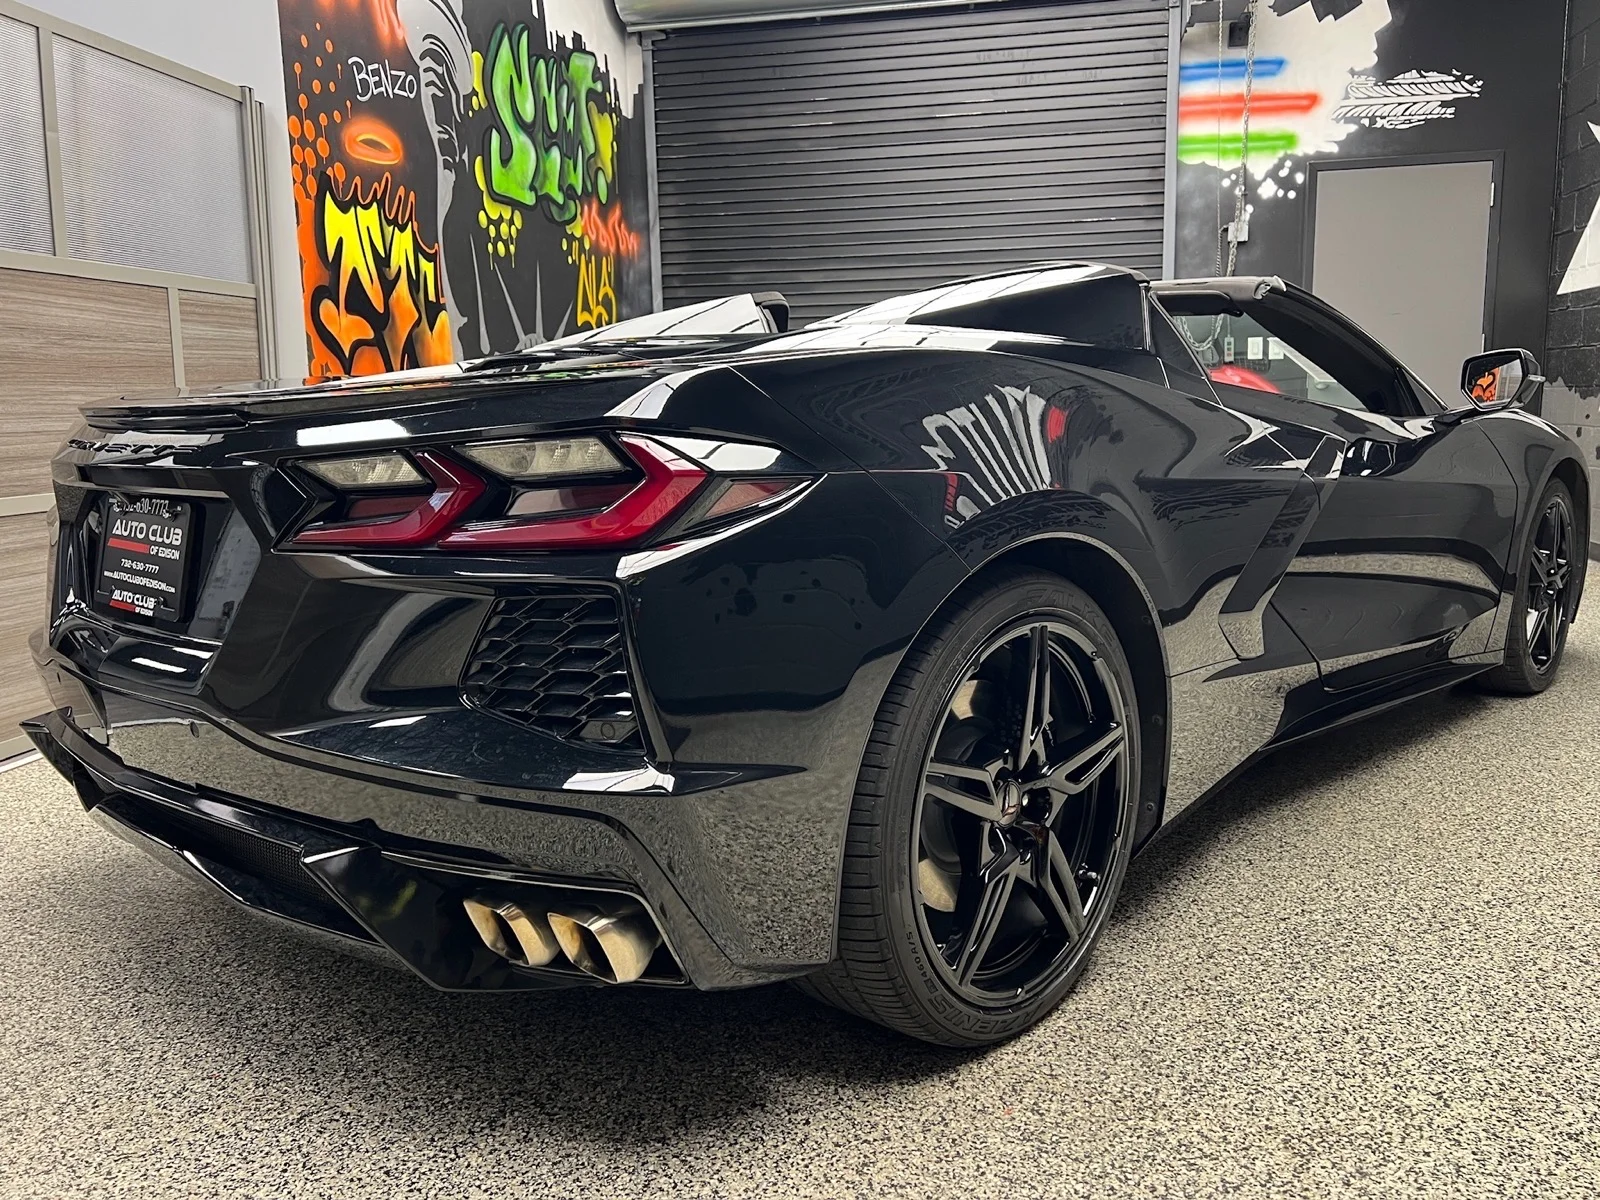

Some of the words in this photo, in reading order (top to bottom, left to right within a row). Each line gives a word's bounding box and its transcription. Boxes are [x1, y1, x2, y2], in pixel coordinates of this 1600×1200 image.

[347, 56, 417, 102] BENZO
[112, 519, 147, 539] AUTO
[148, 524, 182, 546] CLUB
[150, 545, 159, 556] OF
[158, 547, 180, 560] EDISON
[121, 559, 159, 573] 732-630-7777
[112, 589, 133, 603] AUTO
[134, 594, 155, 609] CLUB
